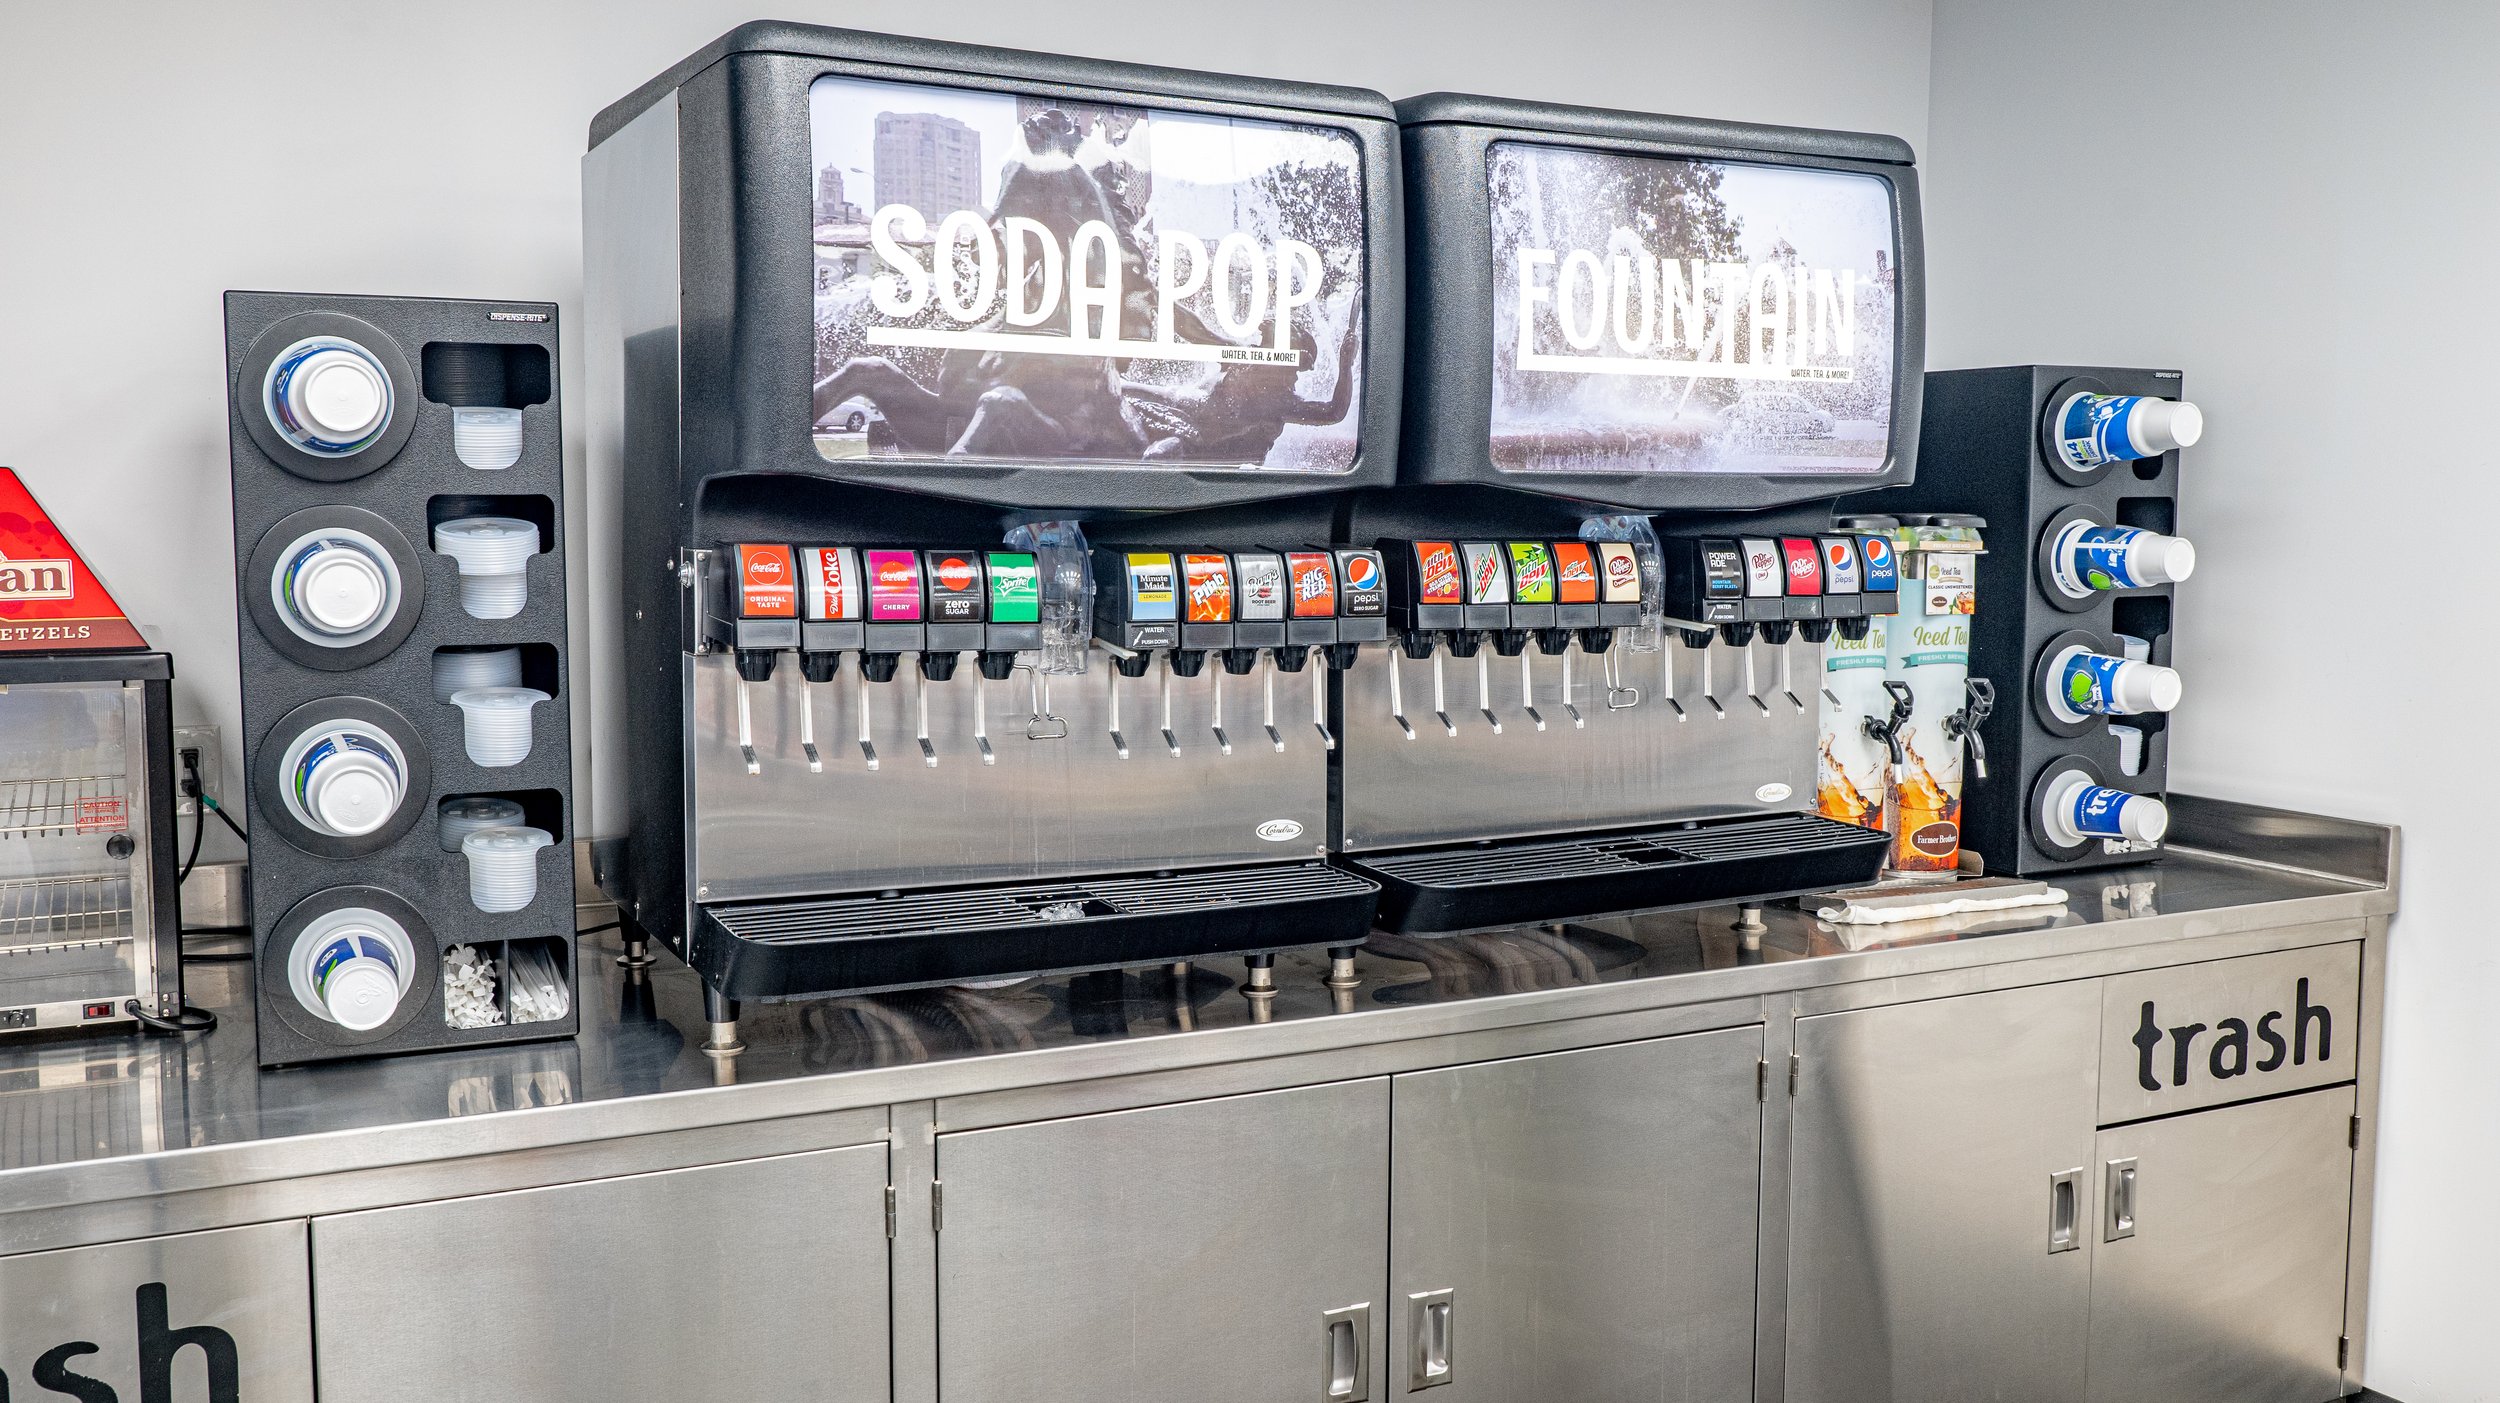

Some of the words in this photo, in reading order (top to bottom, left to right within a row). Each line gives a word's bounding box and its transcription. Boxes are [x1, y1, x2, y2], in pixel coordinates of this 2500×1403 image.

[870, 203, 1123, 342] SODA
[1157, 228, 1324, 350] POP
[1517, 247, 1856, 370] FOUNTAIN
[1221, 349, 1249, 360] WATER,
[1250, 350, 1265, 361] TEA,
[1266, 351, 1272, 362] &
[1273, 352, 1297, 363] MORE!
[1708, 552, 1737, 560] POWER
[1752, 555, 1773, 569] Pepper
[824, 551, 841, 593] Coke
[1791, 560, 1814, 577] Pepper
[1871, 568, 1893, 579] pepsi
[1941, 566, 1953, 576] Iced
[1953, 567, 1961, 576] Tea
[1139, 574, 1169, 583] Minute
[1303, 567, 1323, 586] BIG
[1834, 576, 1855, 585] pepsi
[1001, 576, 1027, 590] Sprite
[1144, 581, 1165, 591] Maid
[1192, 571, 1226, 607] Pibb
[1302, 578, 1327, 602] RED
[757, 601, 780, 609] TASTE
[945, 600, 970, 609] zero
[1354, 593, 1379, 605] pepsi
[882, 603, 910, 611] CHERRY
[1144, 626, 1165, 634] WATER
[1913, 625, 1951, 646] Iced
[1953, 626, 1968, 646] Tea
[1141, 638, 1154, 646] PUSH
[79, 815, 125, 823] ATTENTION
[1917, 834, 1939, 844] Farmer
[2132, 976, 2332, 1092] trash
[0, 1281, 240, 1403] sh
